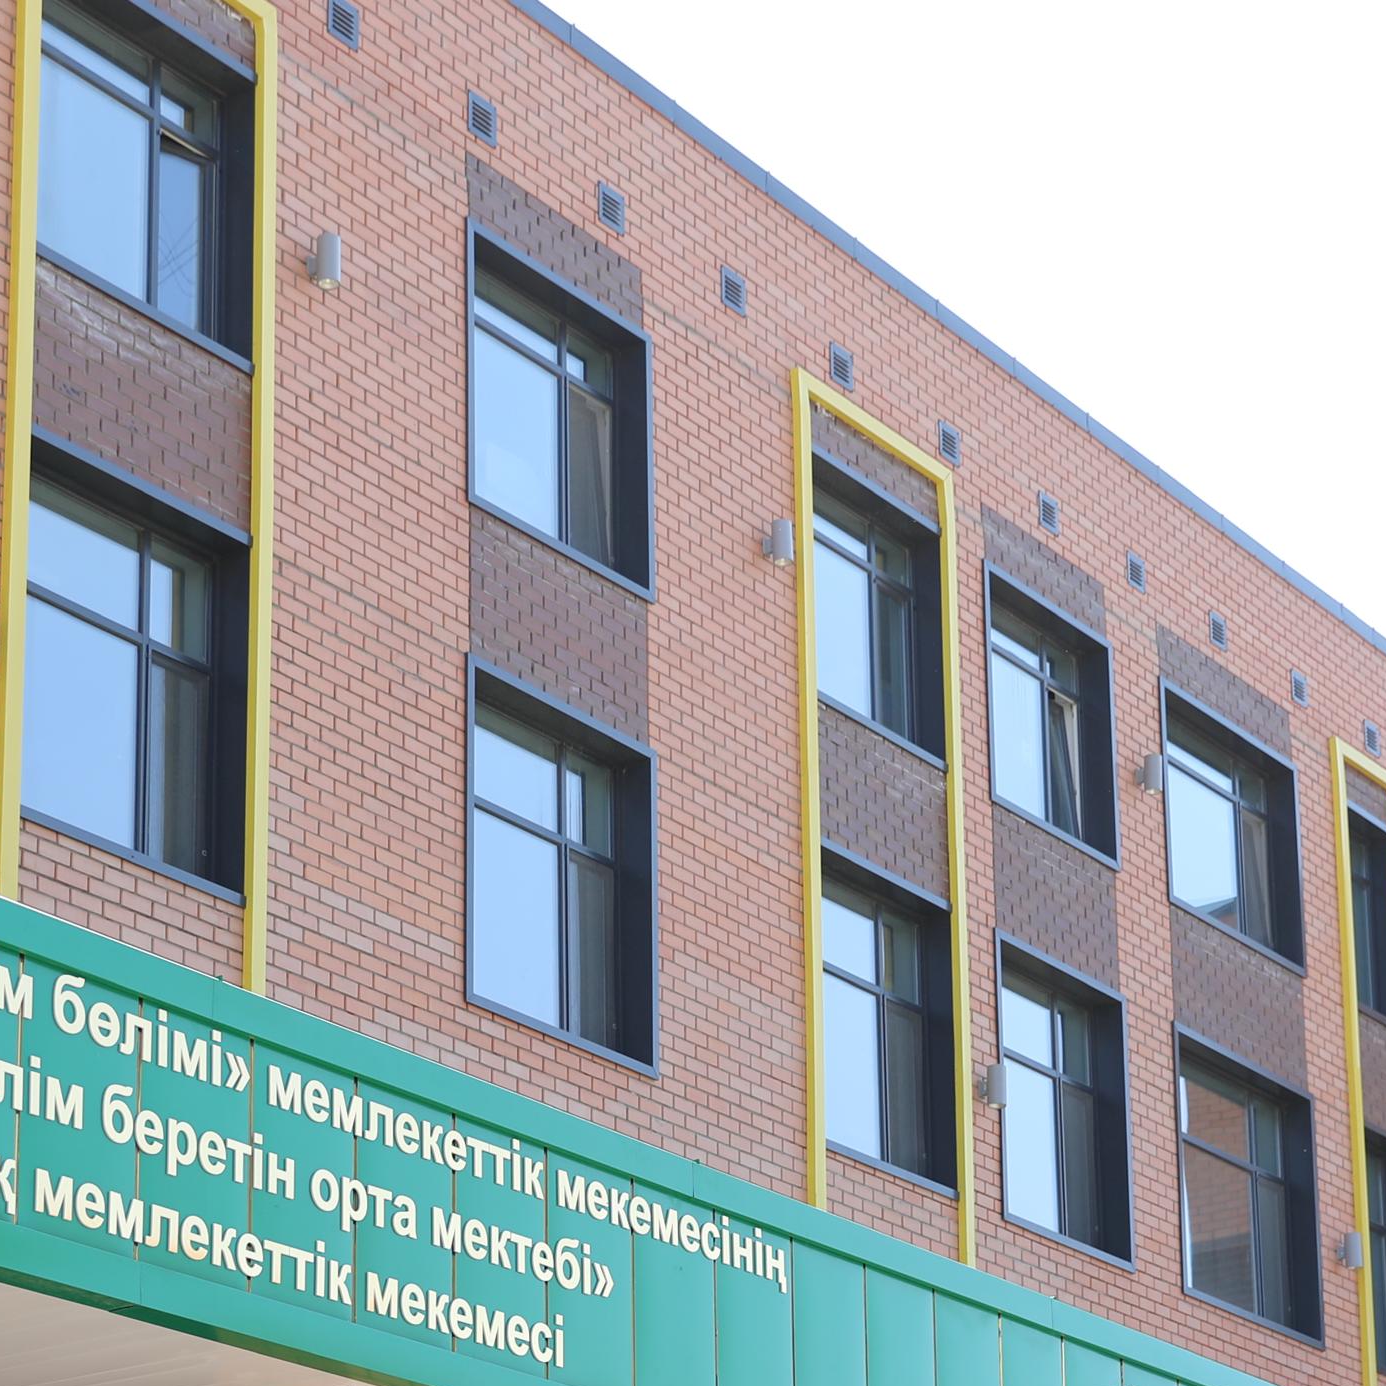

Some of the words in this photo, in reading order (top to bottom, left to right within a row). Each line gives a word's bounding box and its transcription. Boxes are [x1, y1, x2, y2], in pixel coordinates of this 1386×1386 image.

[54, 975, 251, 1091] бөлімі»
[269, 1065, 544, 1199] мемлекеттік
[557, 1170, 788, 1292] мекемесінің
[103, 1085, 295, 1199] беретін
[312, 1168, 417, 1238] орта
[432, 1207, 614, 1297] мектебі»
[35, 1168, 352, 1305] мемлекеттік
[366, 1272, 565, 1368] мекемесі
